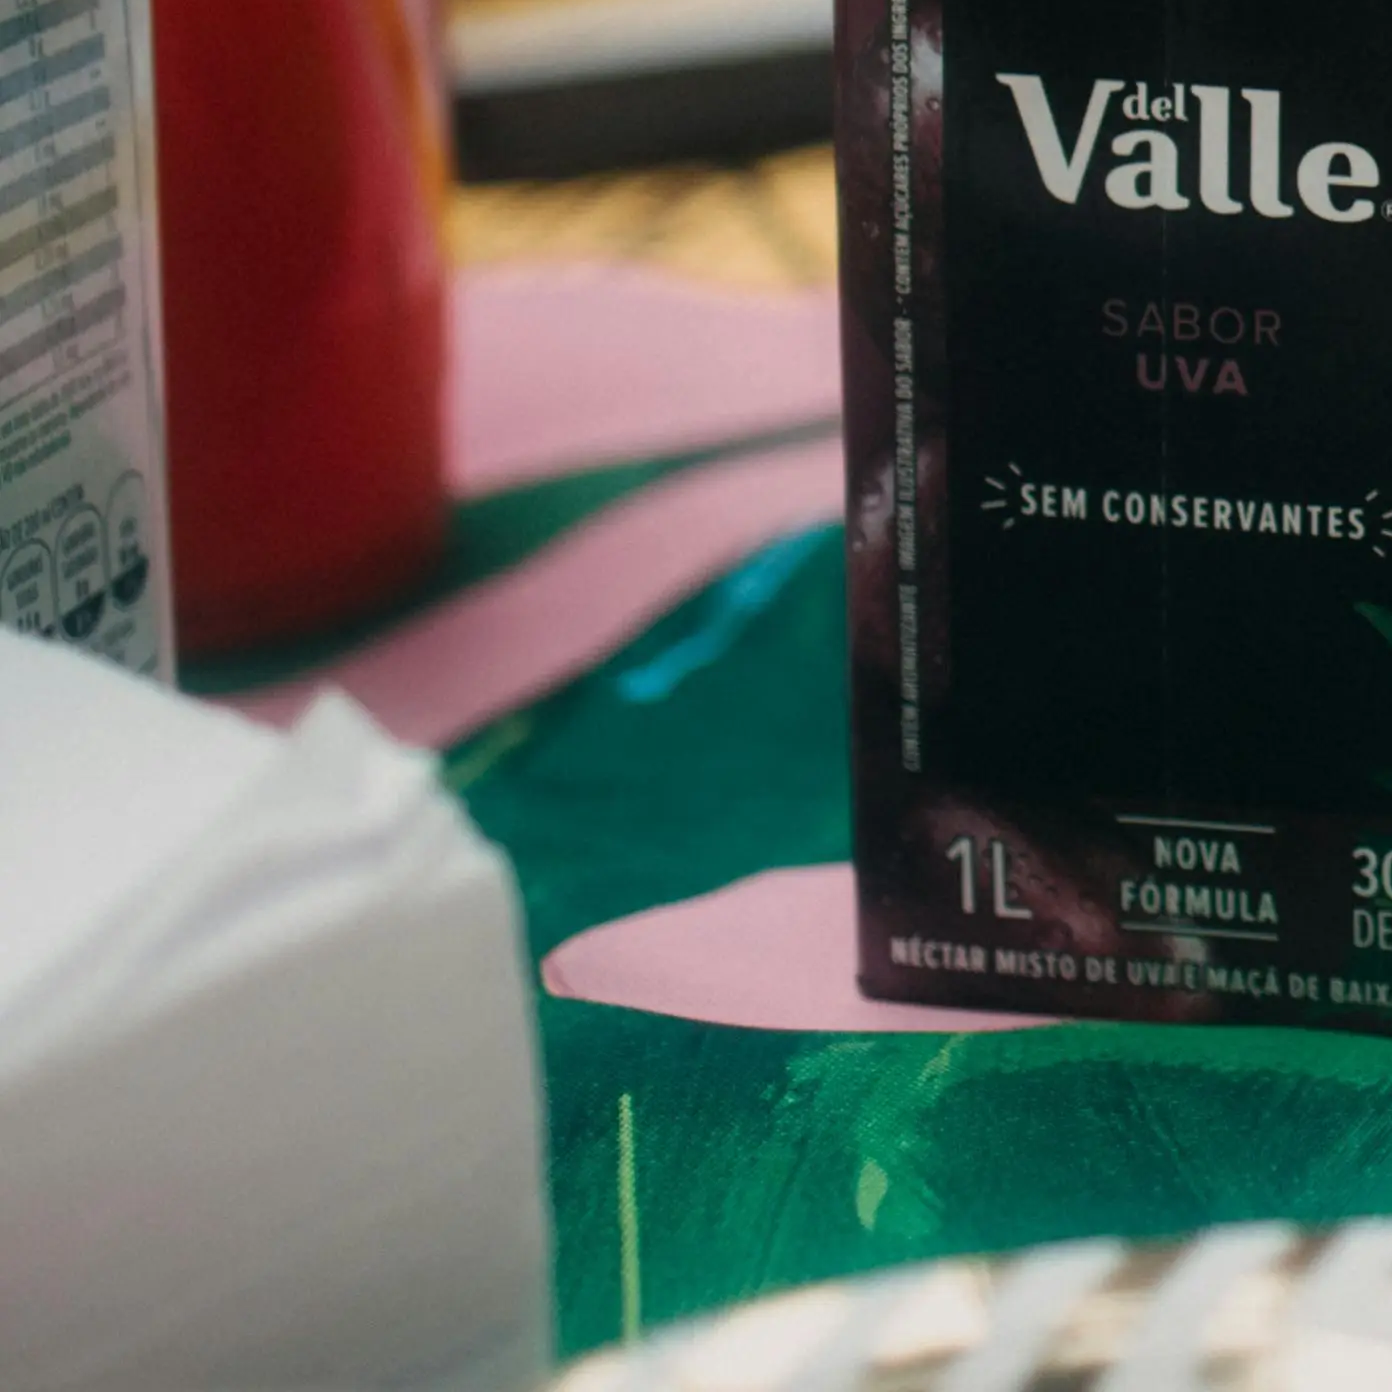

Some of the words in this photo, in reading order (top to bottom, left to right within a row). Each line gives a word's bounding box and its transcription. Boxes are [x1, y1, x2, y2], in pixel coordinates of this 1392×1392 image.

[890, 43, 908, 73] DOS
[889, 76, 909, 152] PRÓPRIOS
[1122, 83, 1189, 121] del
[891, 154, 913, 231] AÇÚCARES
[893, 317, 912, 373] SABOR
[1101, 299, 1282, 347] SABOR
[1136, 353, 1249, 397] UVA
[1020, 483, 1087, 519] SEM
[1102, 491, 1366, 540] CONSERVANTES
[945, 837, 1032, 920] 1L
[1153, 835, 1240, 874] NOVA
[1120, 875, 1279, 925] FÓRMULA
[890, 932, 987, 973] NÉCTAR
[995, 948, 1076, 982] MISTO
[1085, 956, 1117, 984] DE
[1126, 960, 1182, 988] UVA
[1206, 966, 1280, 1000] MAÇÃ
[1288, 973, 1320, 1001] DE
